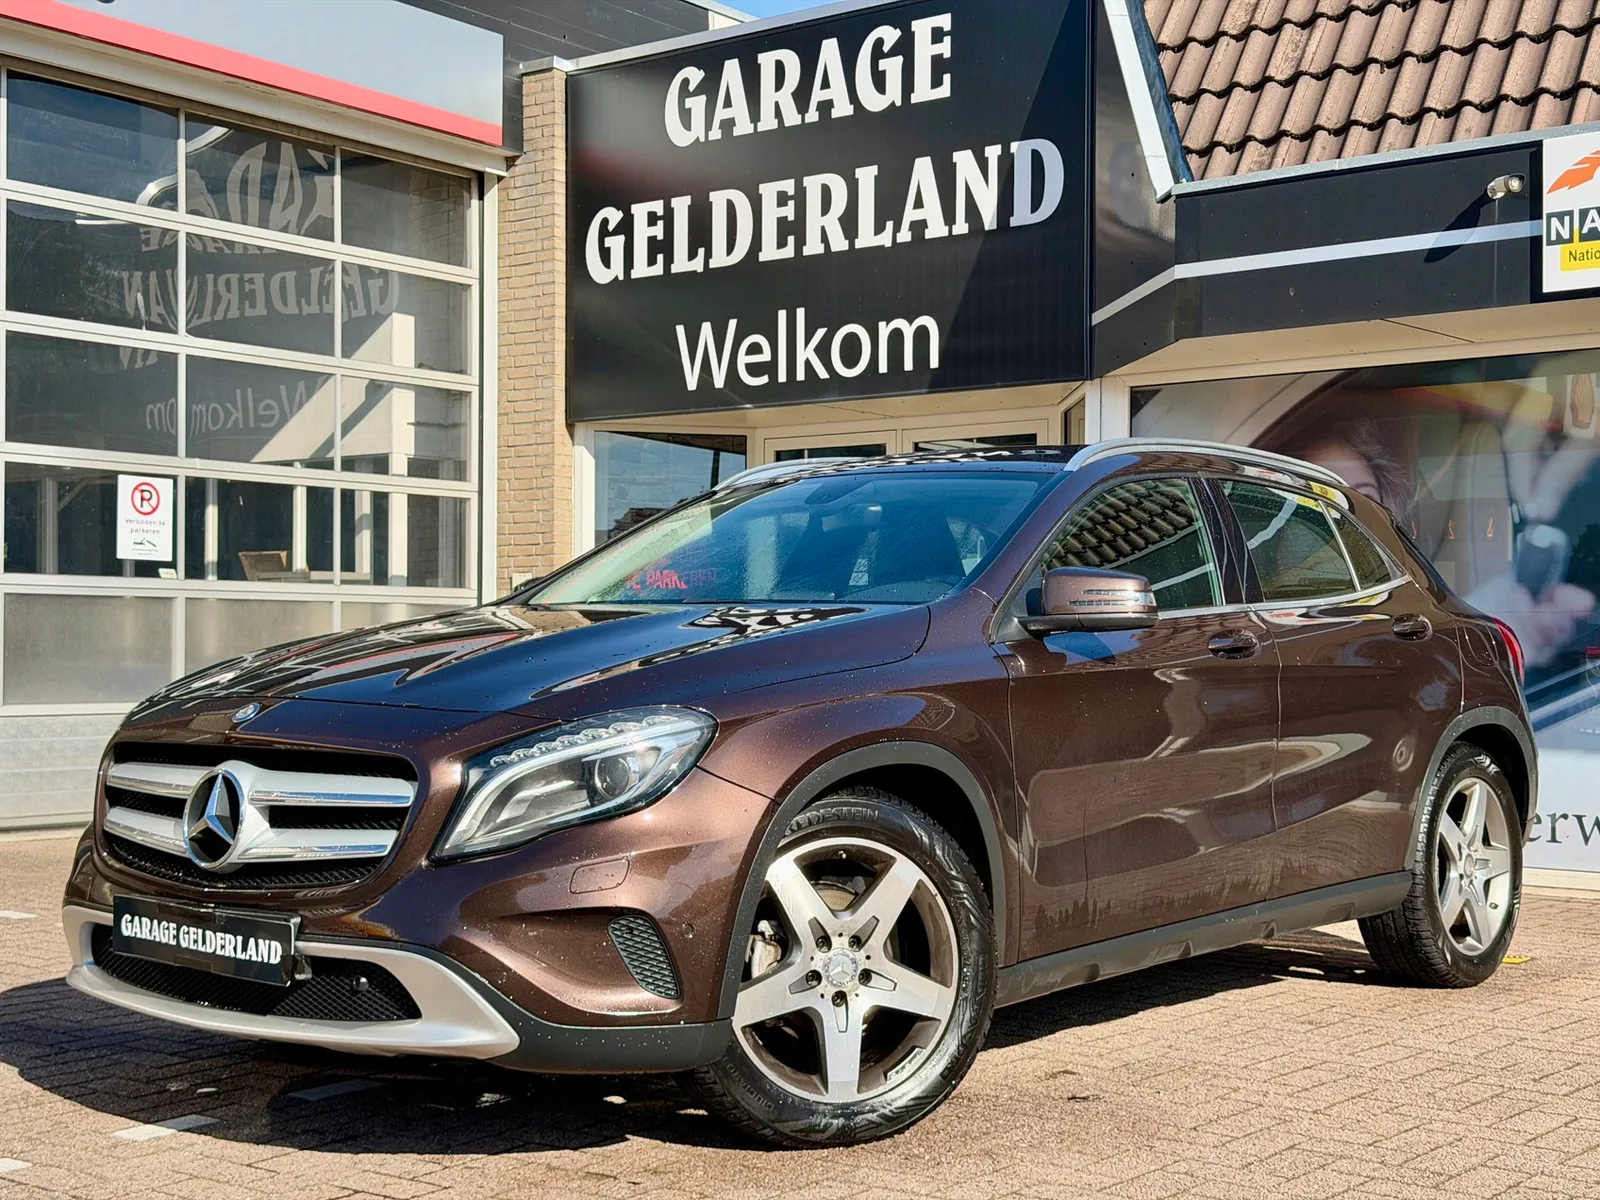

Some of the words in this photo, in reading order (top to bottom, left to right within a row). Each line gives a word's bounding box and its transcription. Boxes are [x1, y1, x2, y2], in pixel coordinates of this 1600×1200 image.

[664, 12, 953, 148] GARAGE
[585, 138, 1065, 285] GELDERLAND
[1568, 247, 1600, 263] Natio
[676, 307, 940, 391] Welkom
[125, 517, 157, 526] Verboden
[130, 527, 161, 535] parkeren
[120, 913, 177, 946] GARAGE
[178, 924, 283, 965] GELDERLAND
